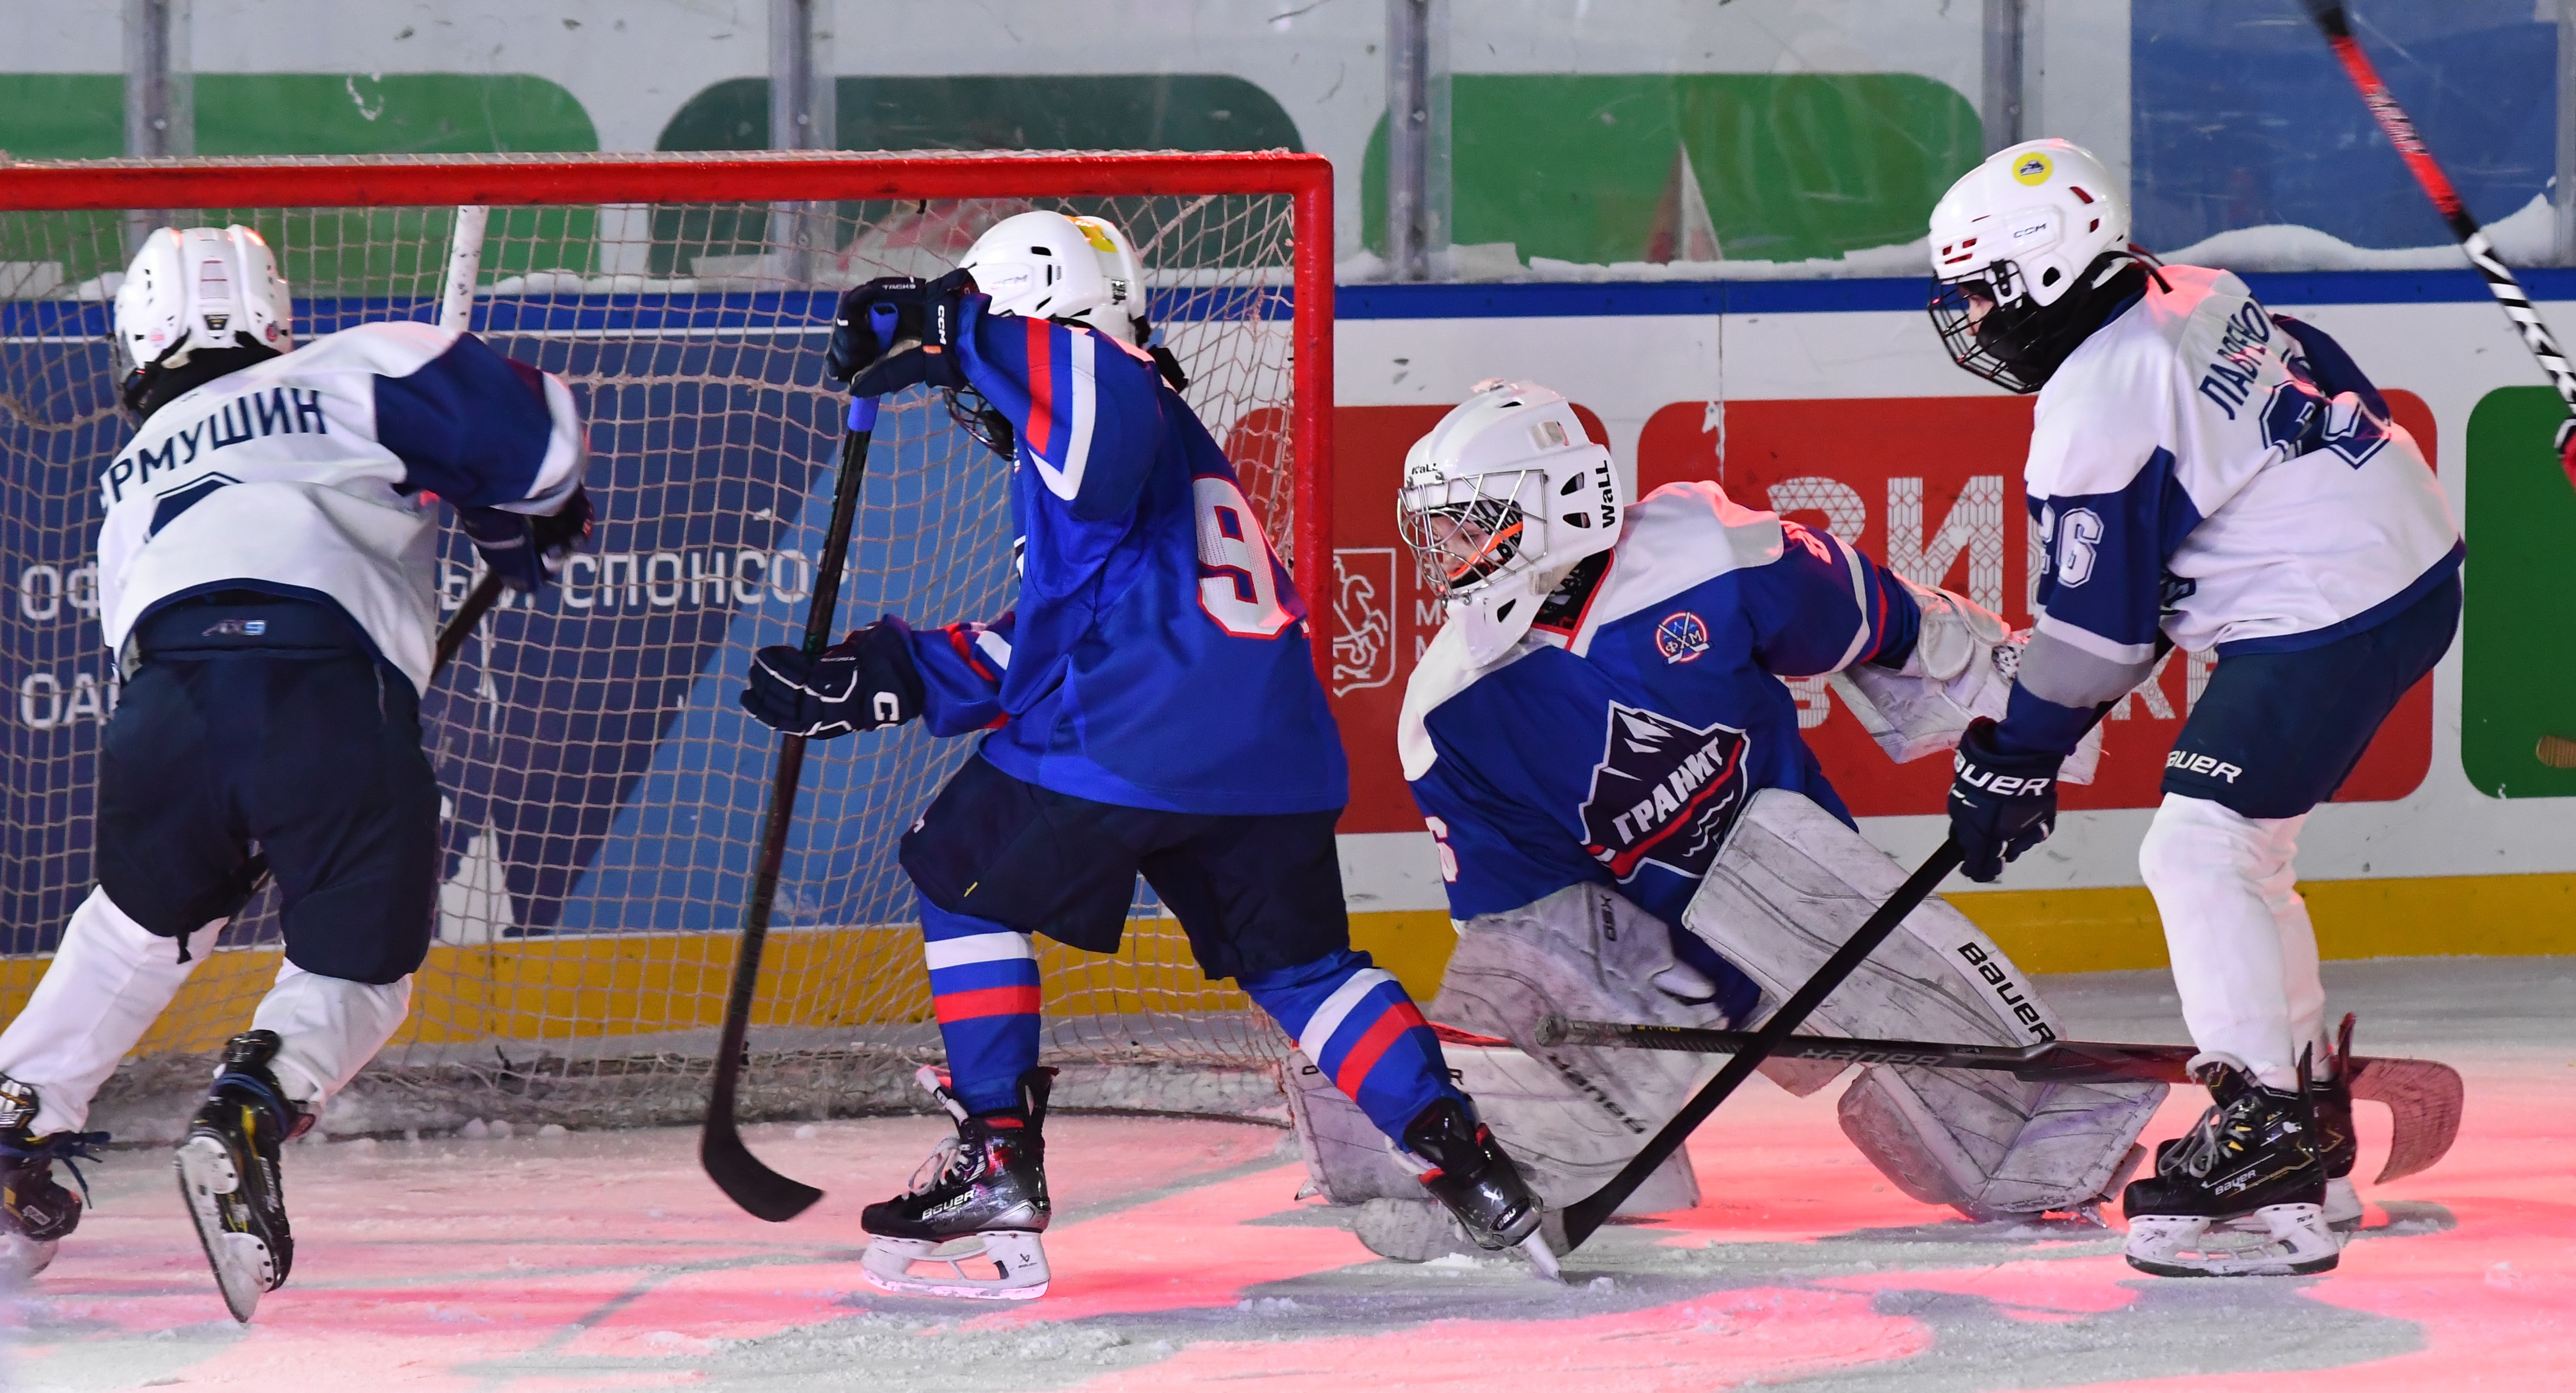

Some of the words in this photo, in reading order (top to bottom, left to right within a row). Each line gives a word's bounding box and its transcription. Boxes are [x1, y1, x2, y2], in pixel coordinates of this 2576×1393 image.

[2013, 222, 2046, 238] CCM
[938, 304, 947, 345] CCM
[2199, 301, 2270, 420] ЛАВРЕНО
[100, 387, 329, 504] РМУШИН
[1190, 473, 1311, 640] 9
[1665, 629, 1703, 653] ФХМ
[1612, 736, 1724, 846] ГРАНИТ
[1957, 942, 2056, 1043] BAUER
